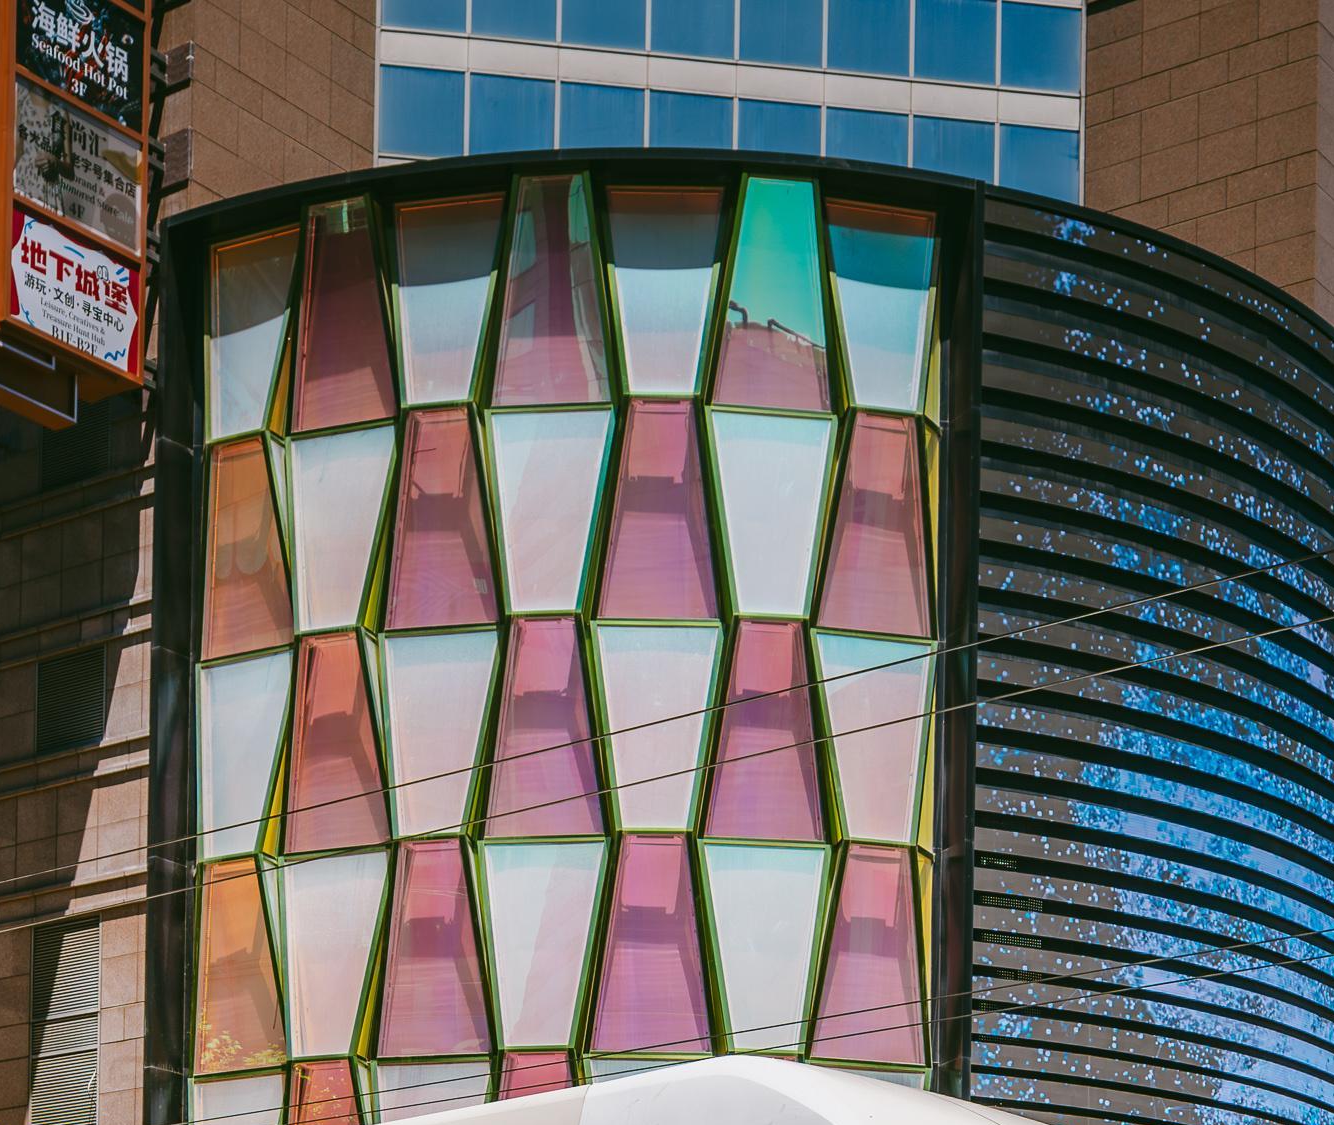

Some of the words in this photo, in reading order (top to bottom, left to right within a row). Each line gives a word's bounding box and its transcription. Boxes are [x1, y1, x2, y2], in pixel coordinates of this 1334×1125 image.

[31, 0, 129, 83] 海鲜火锅
[31, 33, 81, 72] Seafood
[84, 62, 106, 87] Hot
[107, 76, 128, 100] Pot
[70, 78, 87, 97] 3F
[21, 236, 128, 315] 地下城堡
[24, 271, 124, 333] 游玩·文创·寻宝中心
[41, 309, 72, 330] Treasure
[72, 322, 91, 339] Hunt
[91, 332, 105, 346] Hub
[68, 310, 99, 333] Creatives
[100, 327, 106, 335] &
